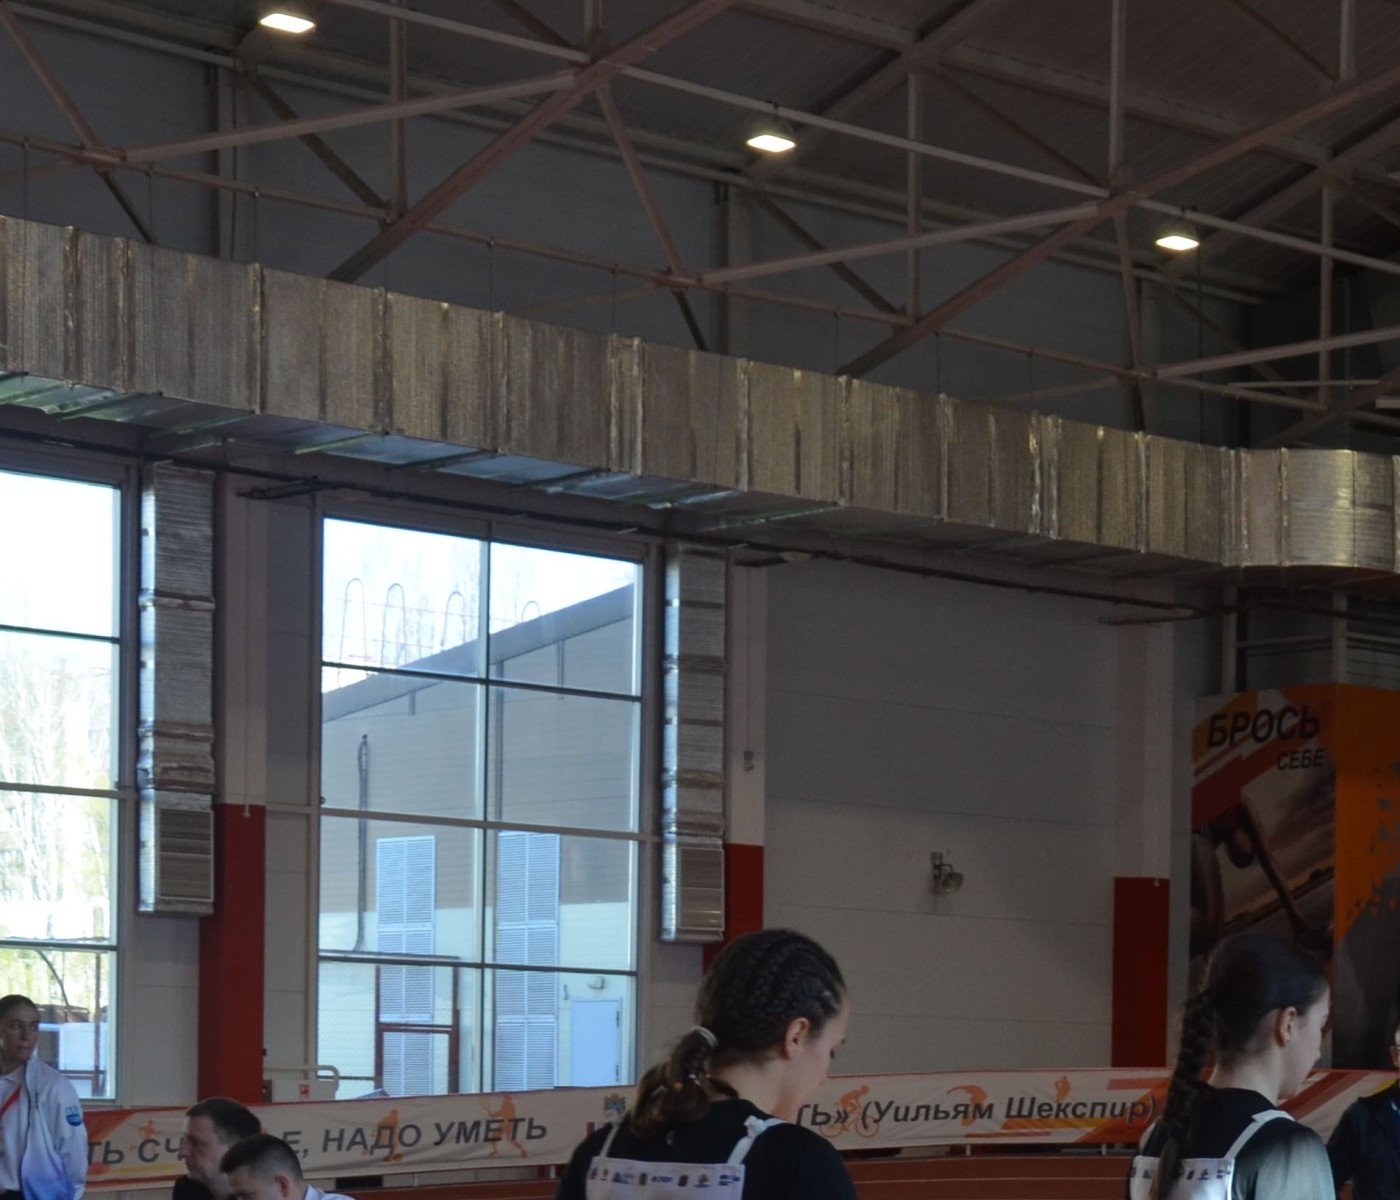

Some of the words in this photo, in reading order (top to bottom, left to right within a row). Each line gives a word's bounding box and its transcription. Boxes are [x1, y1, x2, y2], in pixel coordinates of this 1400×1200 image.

[1206, 705, 1320, 749] БРОСЬ
[1276, 748, 1325, 771] СЕБЕ
[861, 1100, 994, 1130] (Уильям
[1004, 1096, 1158, 1126] Шекспир)
[322, 1123, 421, 1158] НАДО
[433, 1117, 548, 1148] УМЕТЬ
